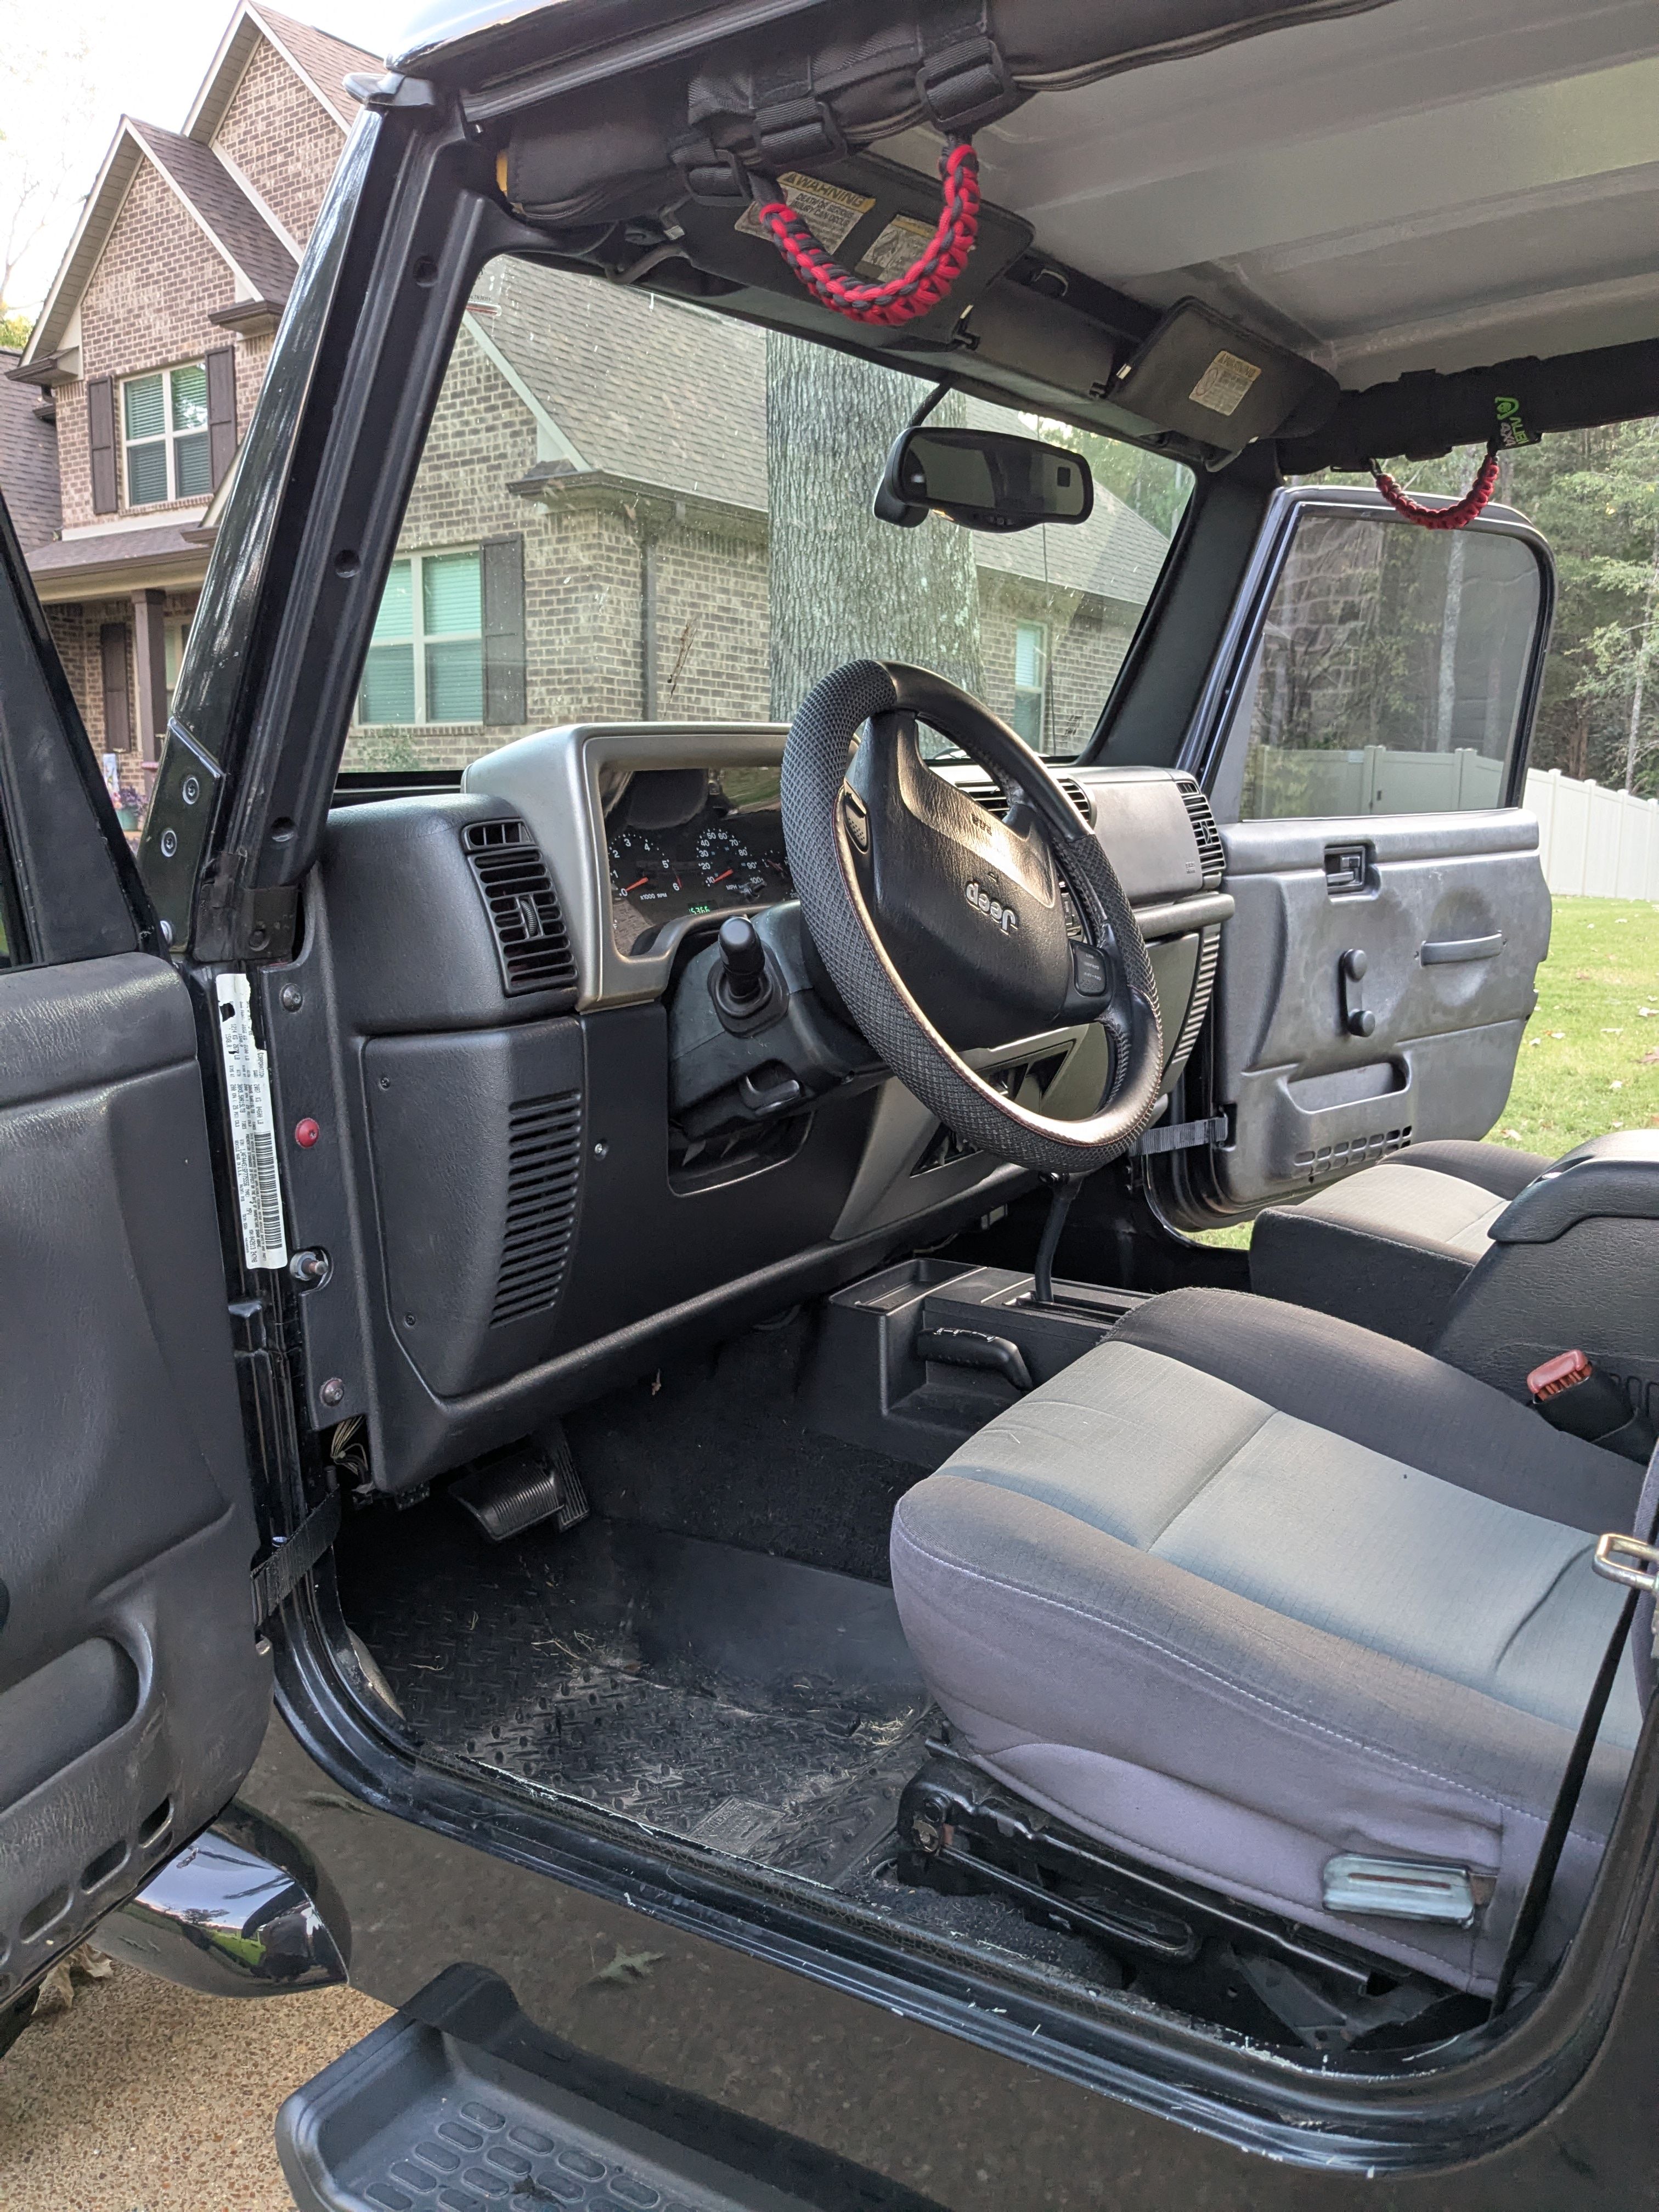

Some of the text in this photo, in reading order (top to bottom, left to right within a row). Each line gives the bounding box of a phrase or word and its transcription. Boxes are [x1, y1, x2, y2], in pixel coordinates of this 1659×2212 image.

[795, 193, 817, 206] DEATH
[624, 838, 631, 847] 3
[644, 843, 650, 851] 4
[612, 850, 620, 858] 2
[662, 860, 669, 868] 5
[613, 870, 618, 878] 1
[673, 883, 680, 891] 6
[620, 888, 628, 896] 0
[966, 882, 1017, 932] Jeep
[257, 1052, 266, 1078] CORPORATION
